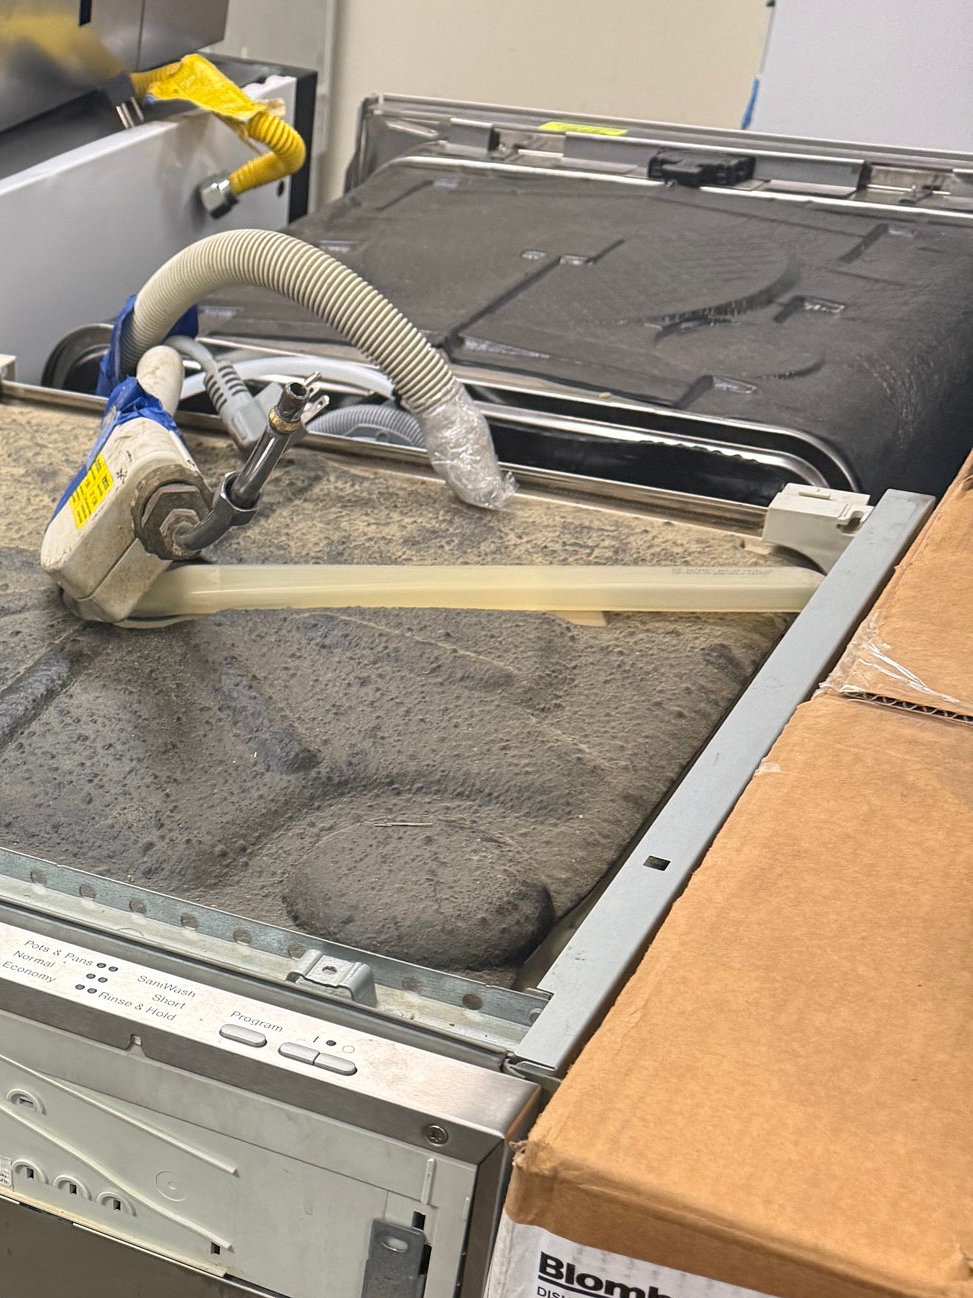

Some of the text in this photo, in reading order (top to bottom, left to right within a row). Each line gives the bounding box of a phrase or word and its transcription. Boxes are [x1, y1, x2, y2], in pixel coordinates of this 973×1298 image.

[13, 950, 56, 969] Normal
[24, 939, 94, 967] Pots & Pans
[2, 960, 57, 984] Economy
[136, 974, 197, 999] SaniWash
[98, 991, 177, 1021] Rinse & Hold
[151, 993, 186, 1010] Short
[230, 1010, 284, 1034] Program
